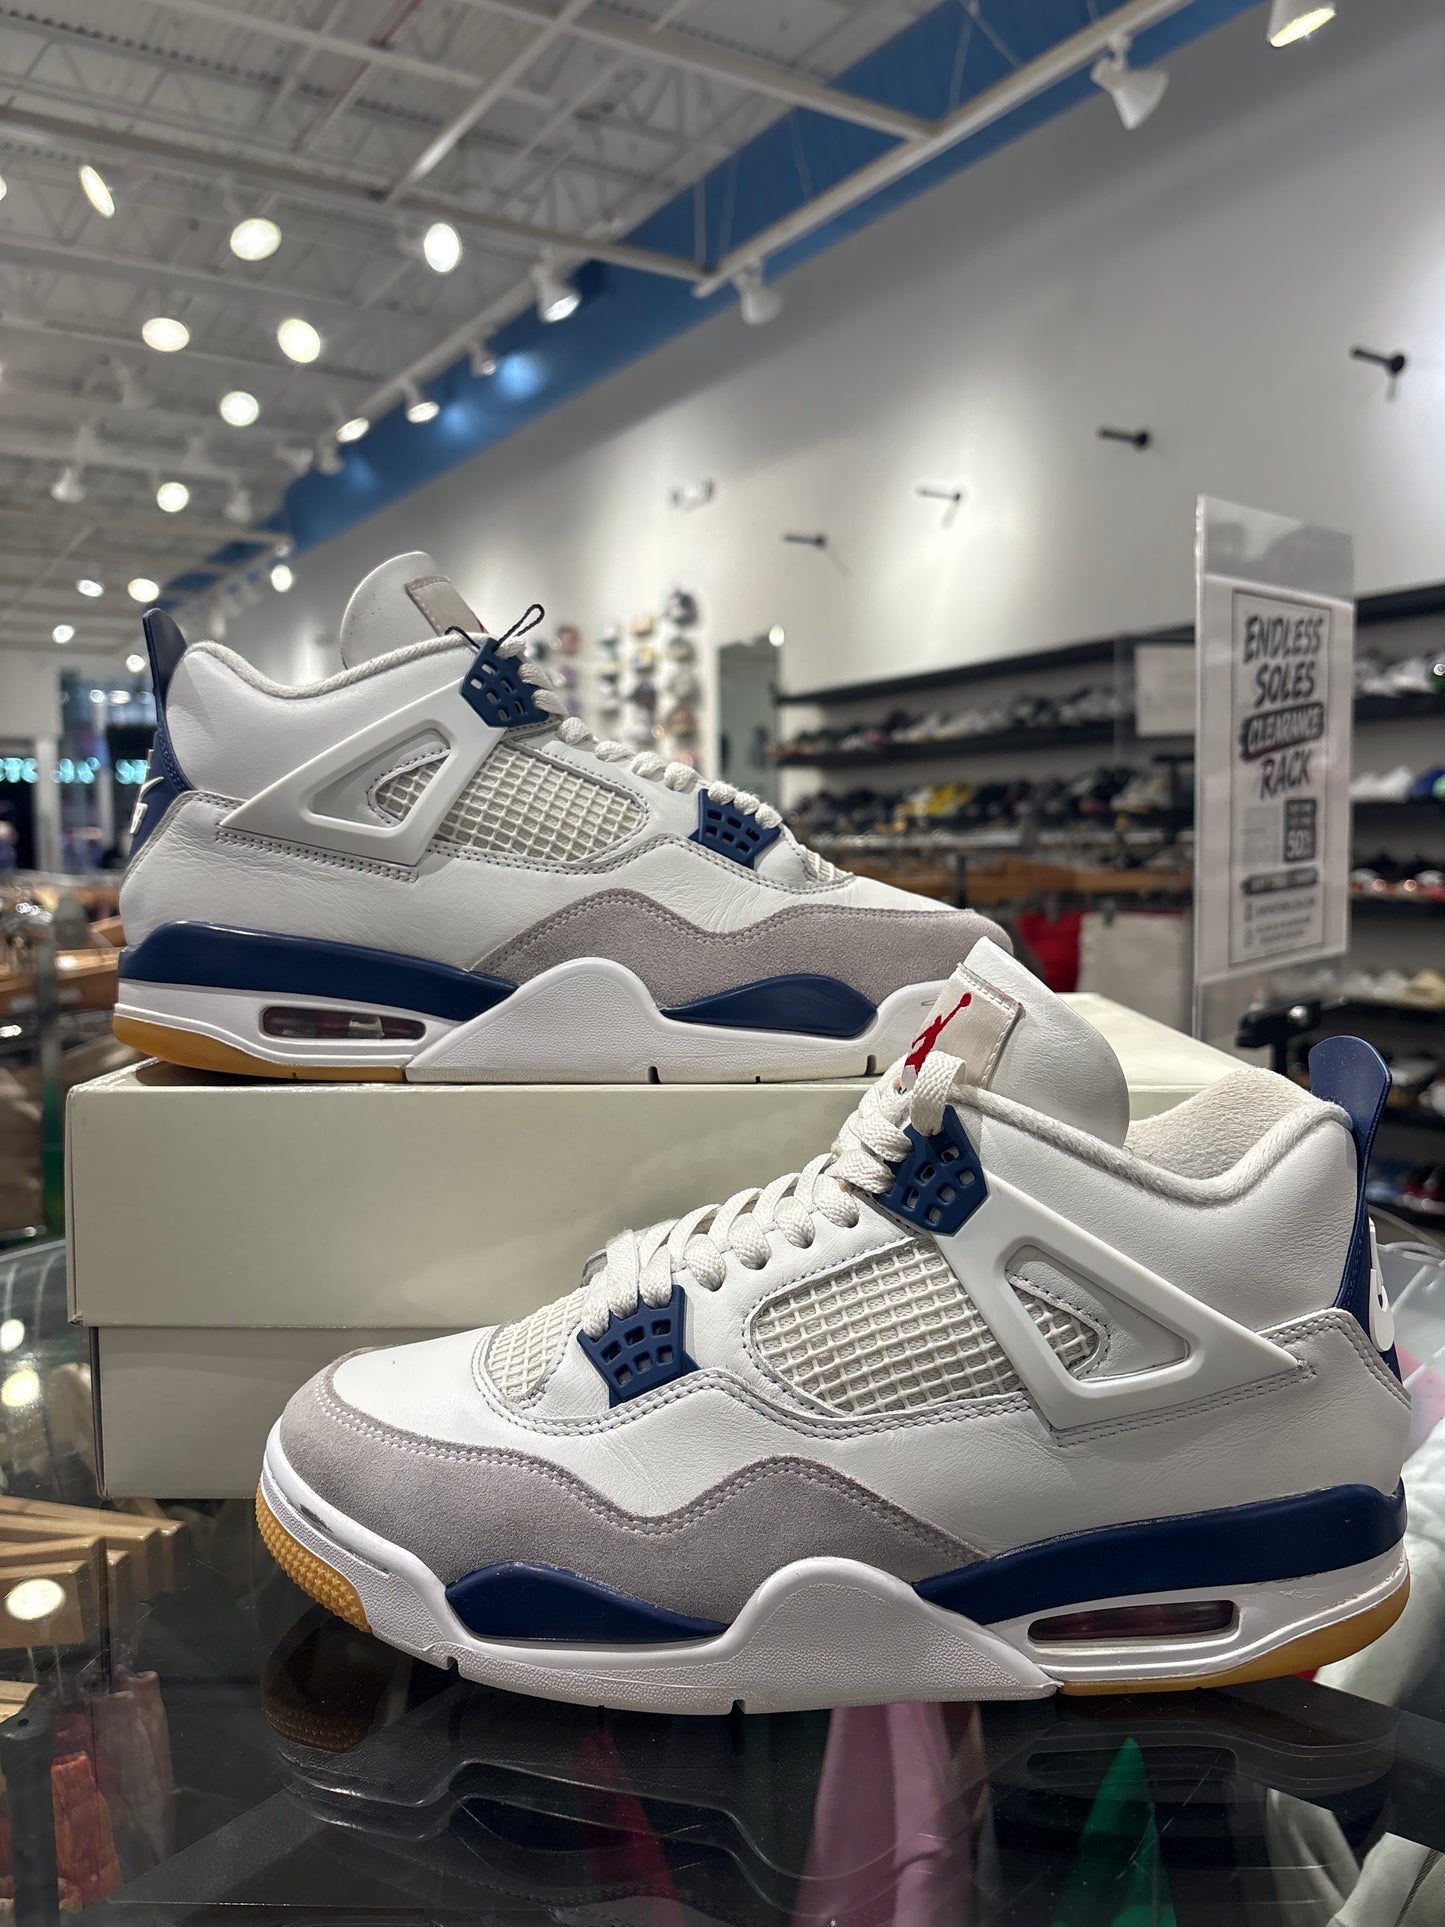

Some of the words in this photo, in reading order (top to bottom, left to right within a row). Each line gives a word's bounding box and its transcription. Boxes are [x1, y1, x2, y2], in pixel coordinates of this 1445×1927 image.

[1243, 615, 1323, 664] ENDLESS
[1254, 660, 1315, 708] SOLES
[1247, 705, 1321, 753] CLEARANCE
[1260, 749, 1311, 800] RACK
